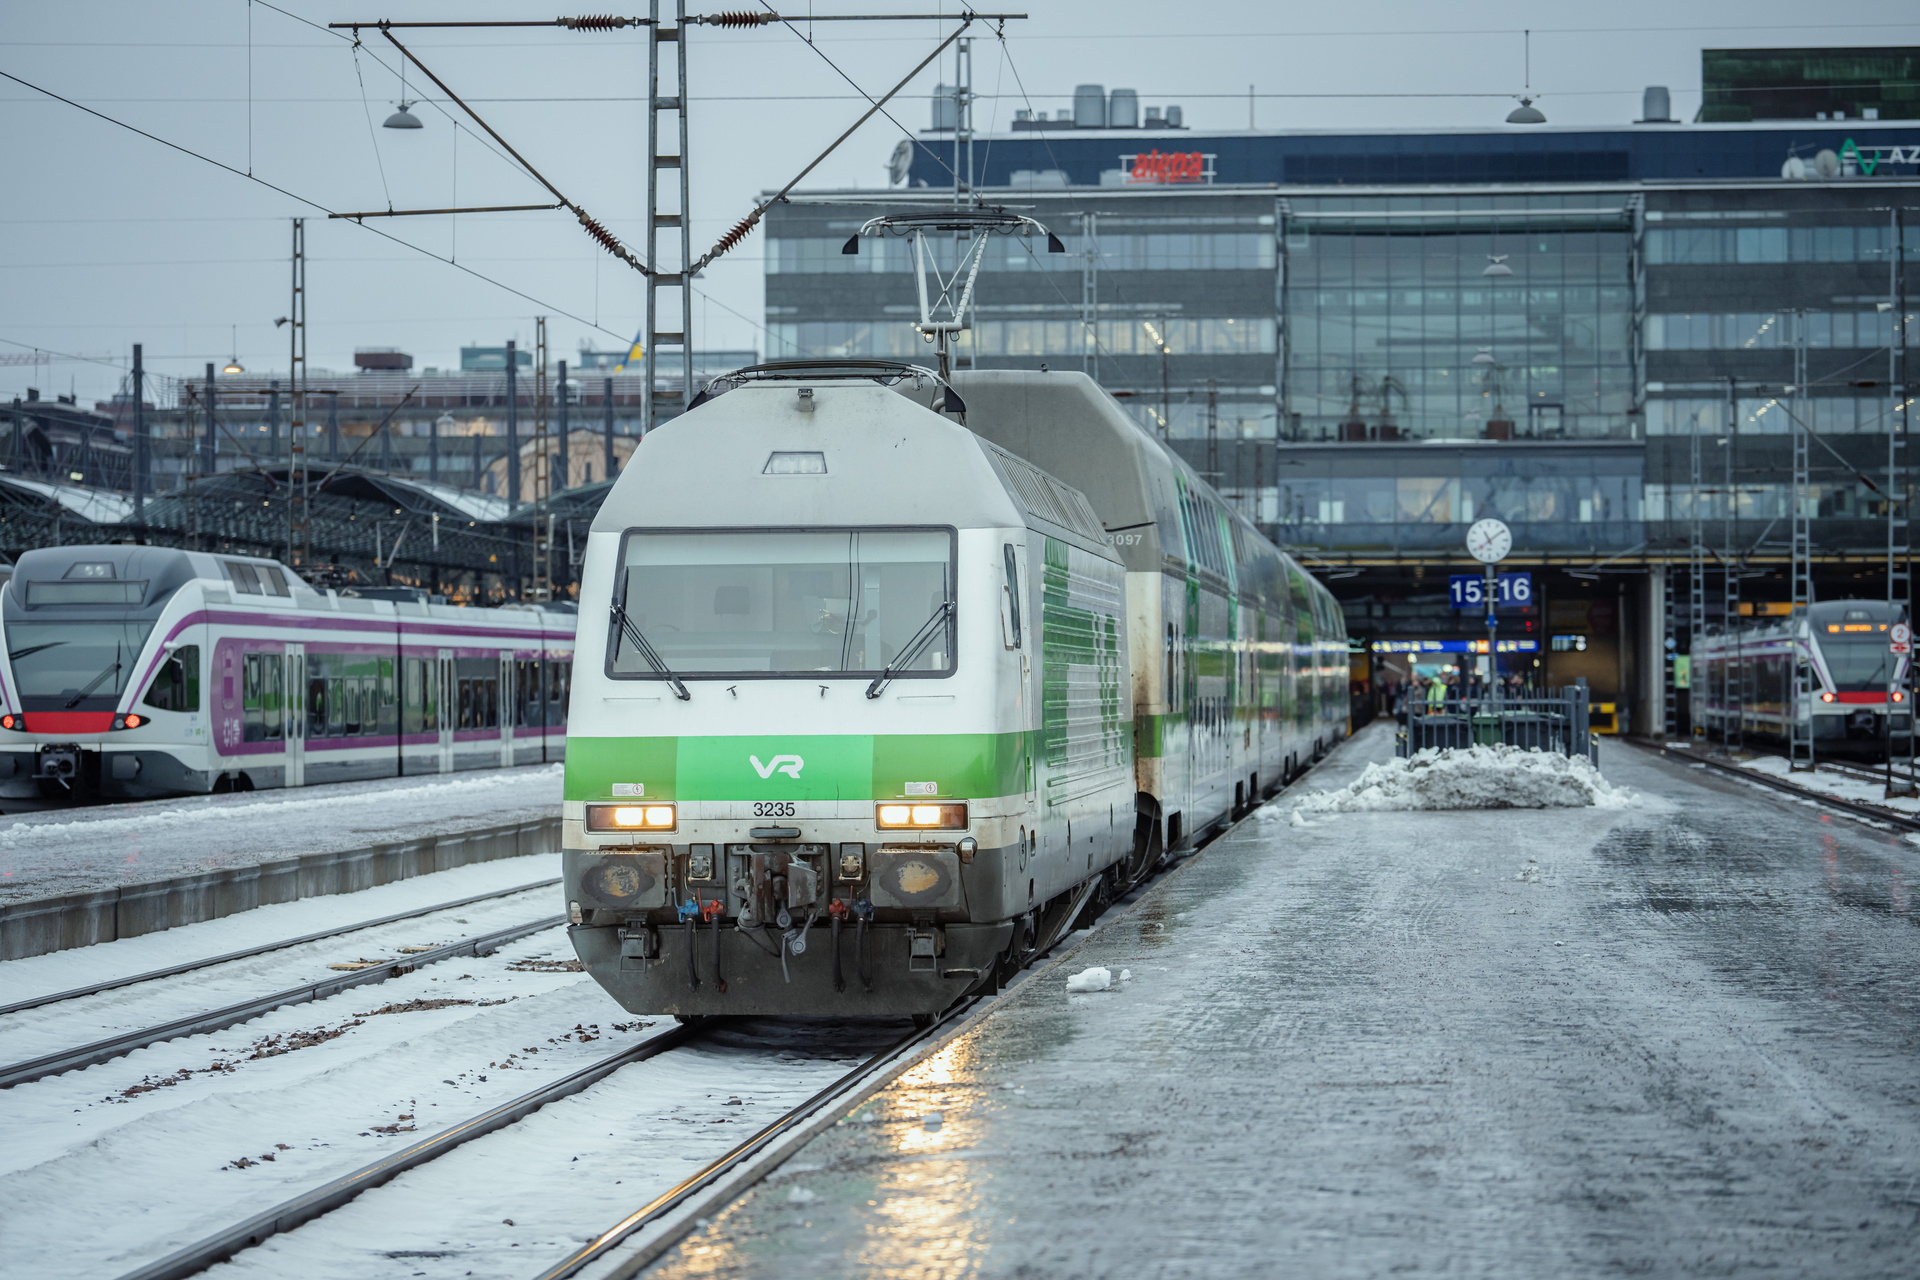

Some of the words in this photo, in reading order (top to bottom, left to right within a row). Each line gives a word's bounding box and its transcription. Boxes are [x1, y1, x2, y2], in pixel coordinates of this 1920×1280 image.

[1131, 149, 1203, 183] alepa
[1451, 580, 1481, 603] 15
[1499, 577, 1530, 601] 16
[1896, 627, 1904, 639] 2
[749, 754, 805, 779] VR
[753, 802, 795, 817] 3235
